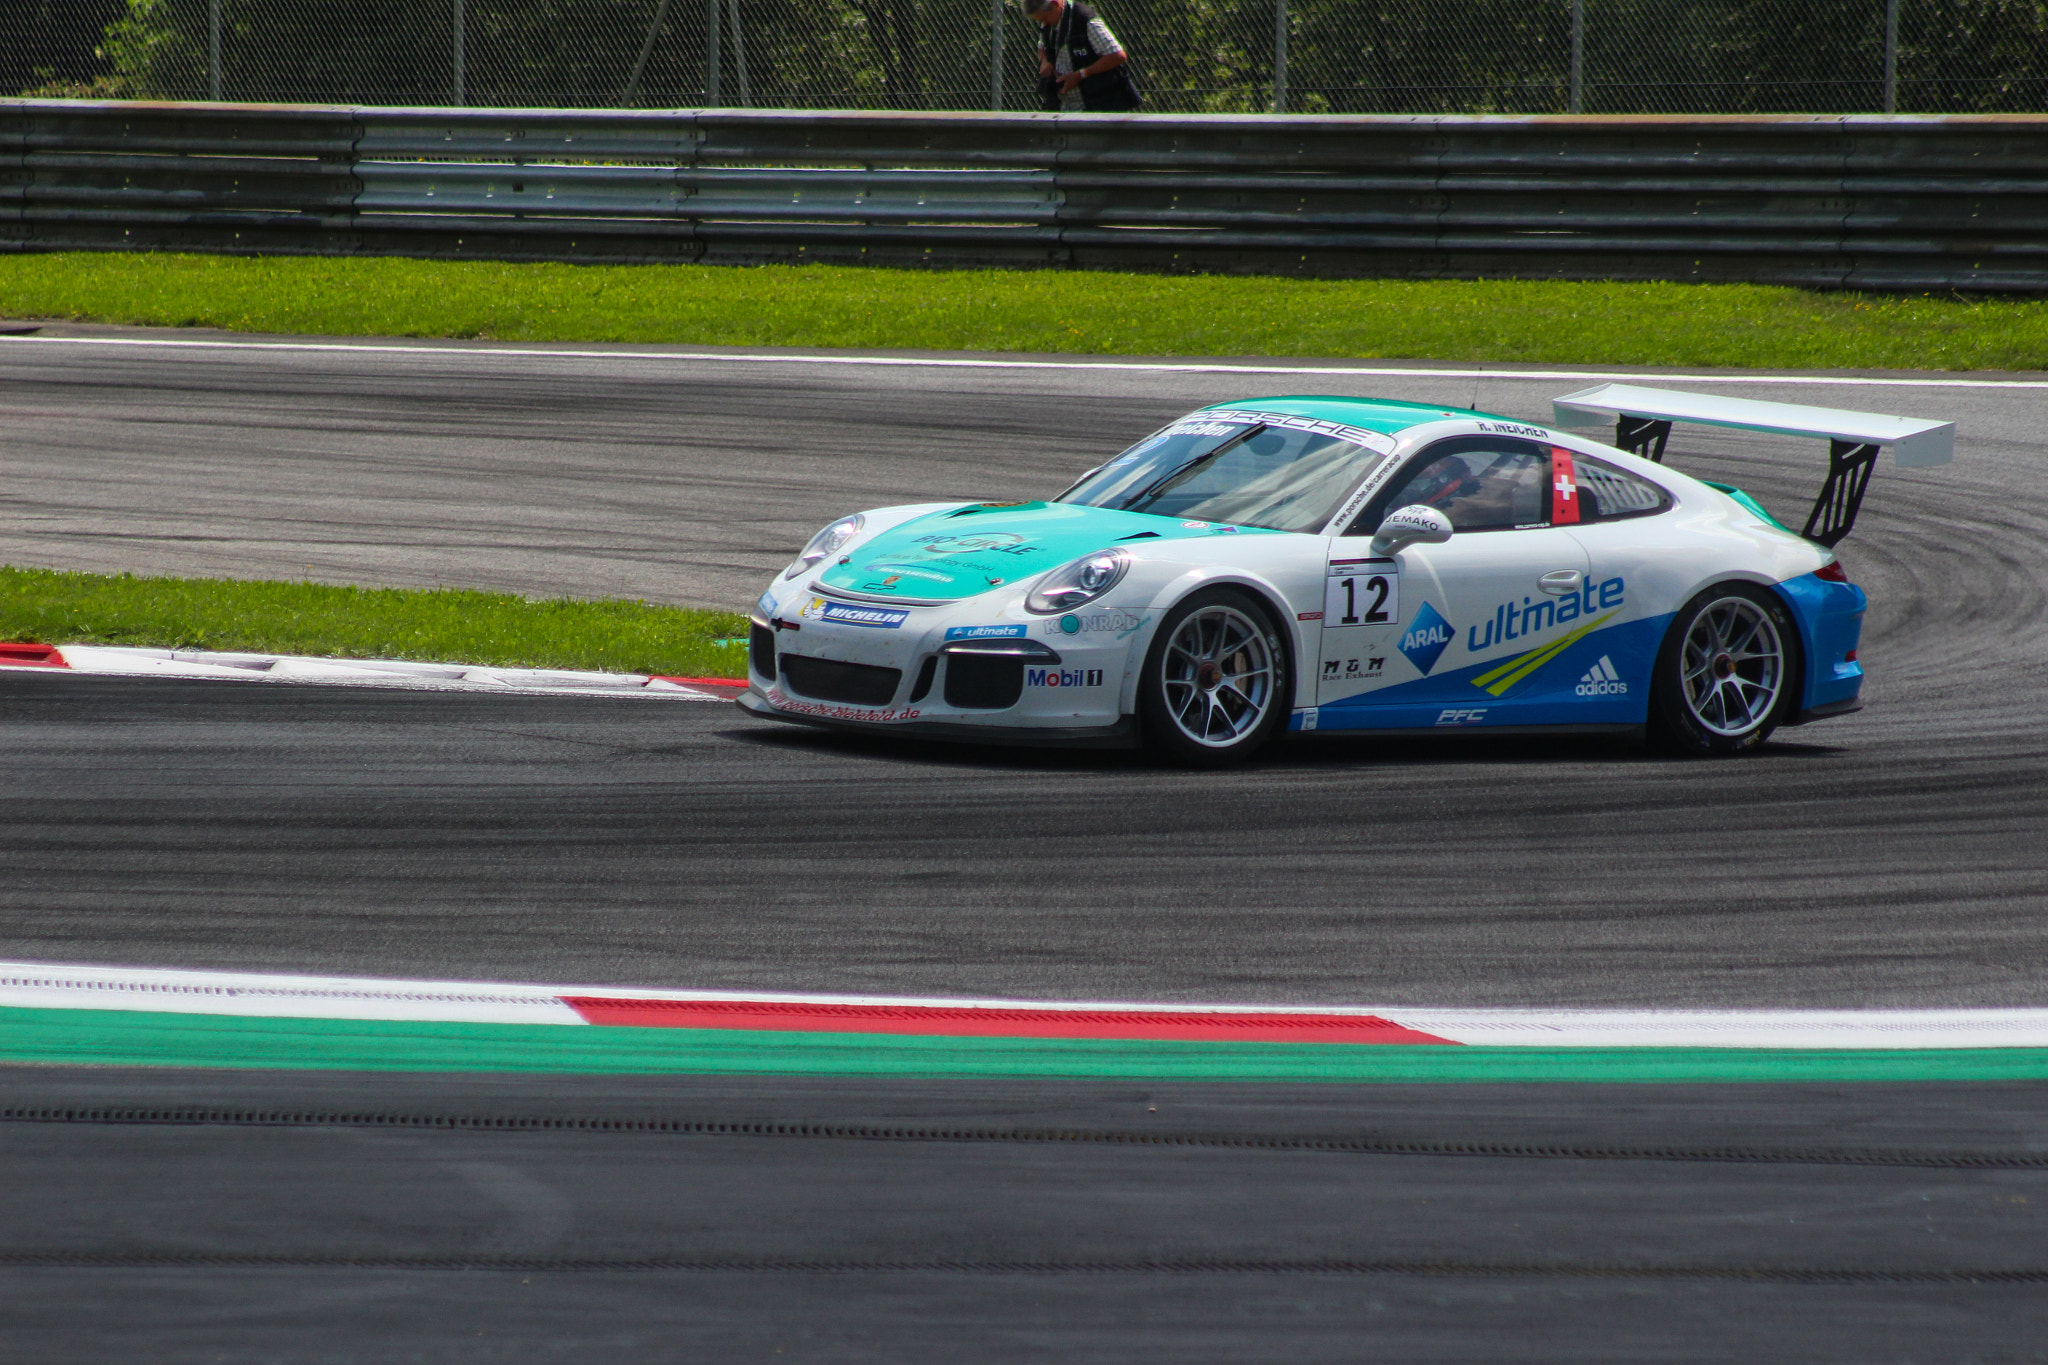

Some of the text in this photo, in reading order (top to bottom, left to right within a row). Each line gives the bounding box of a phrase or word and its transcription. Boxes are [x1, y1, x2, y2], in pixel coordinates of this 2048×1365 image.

[1186, 411, 1372, 442] PORSCHE
[1387, 515, 1439, 532] JEMAKO
[1341, 575, 1390, 625] 12
[826, 607, 906, 624] MICHELIN
[1467, 575, 1625, 652] ultimate
[967, 626, 1019, 637] ultimate
[1403, 624, 1449, 651] ARAL
[1324, 660, 1341, 674] M
[1368, 657, 1386, 671] M
[1028, 669, 1103, 687] Mobil 1
[1575, 680, 1628, 696] adidas
[1437, 709, 1488, 722] PFC
